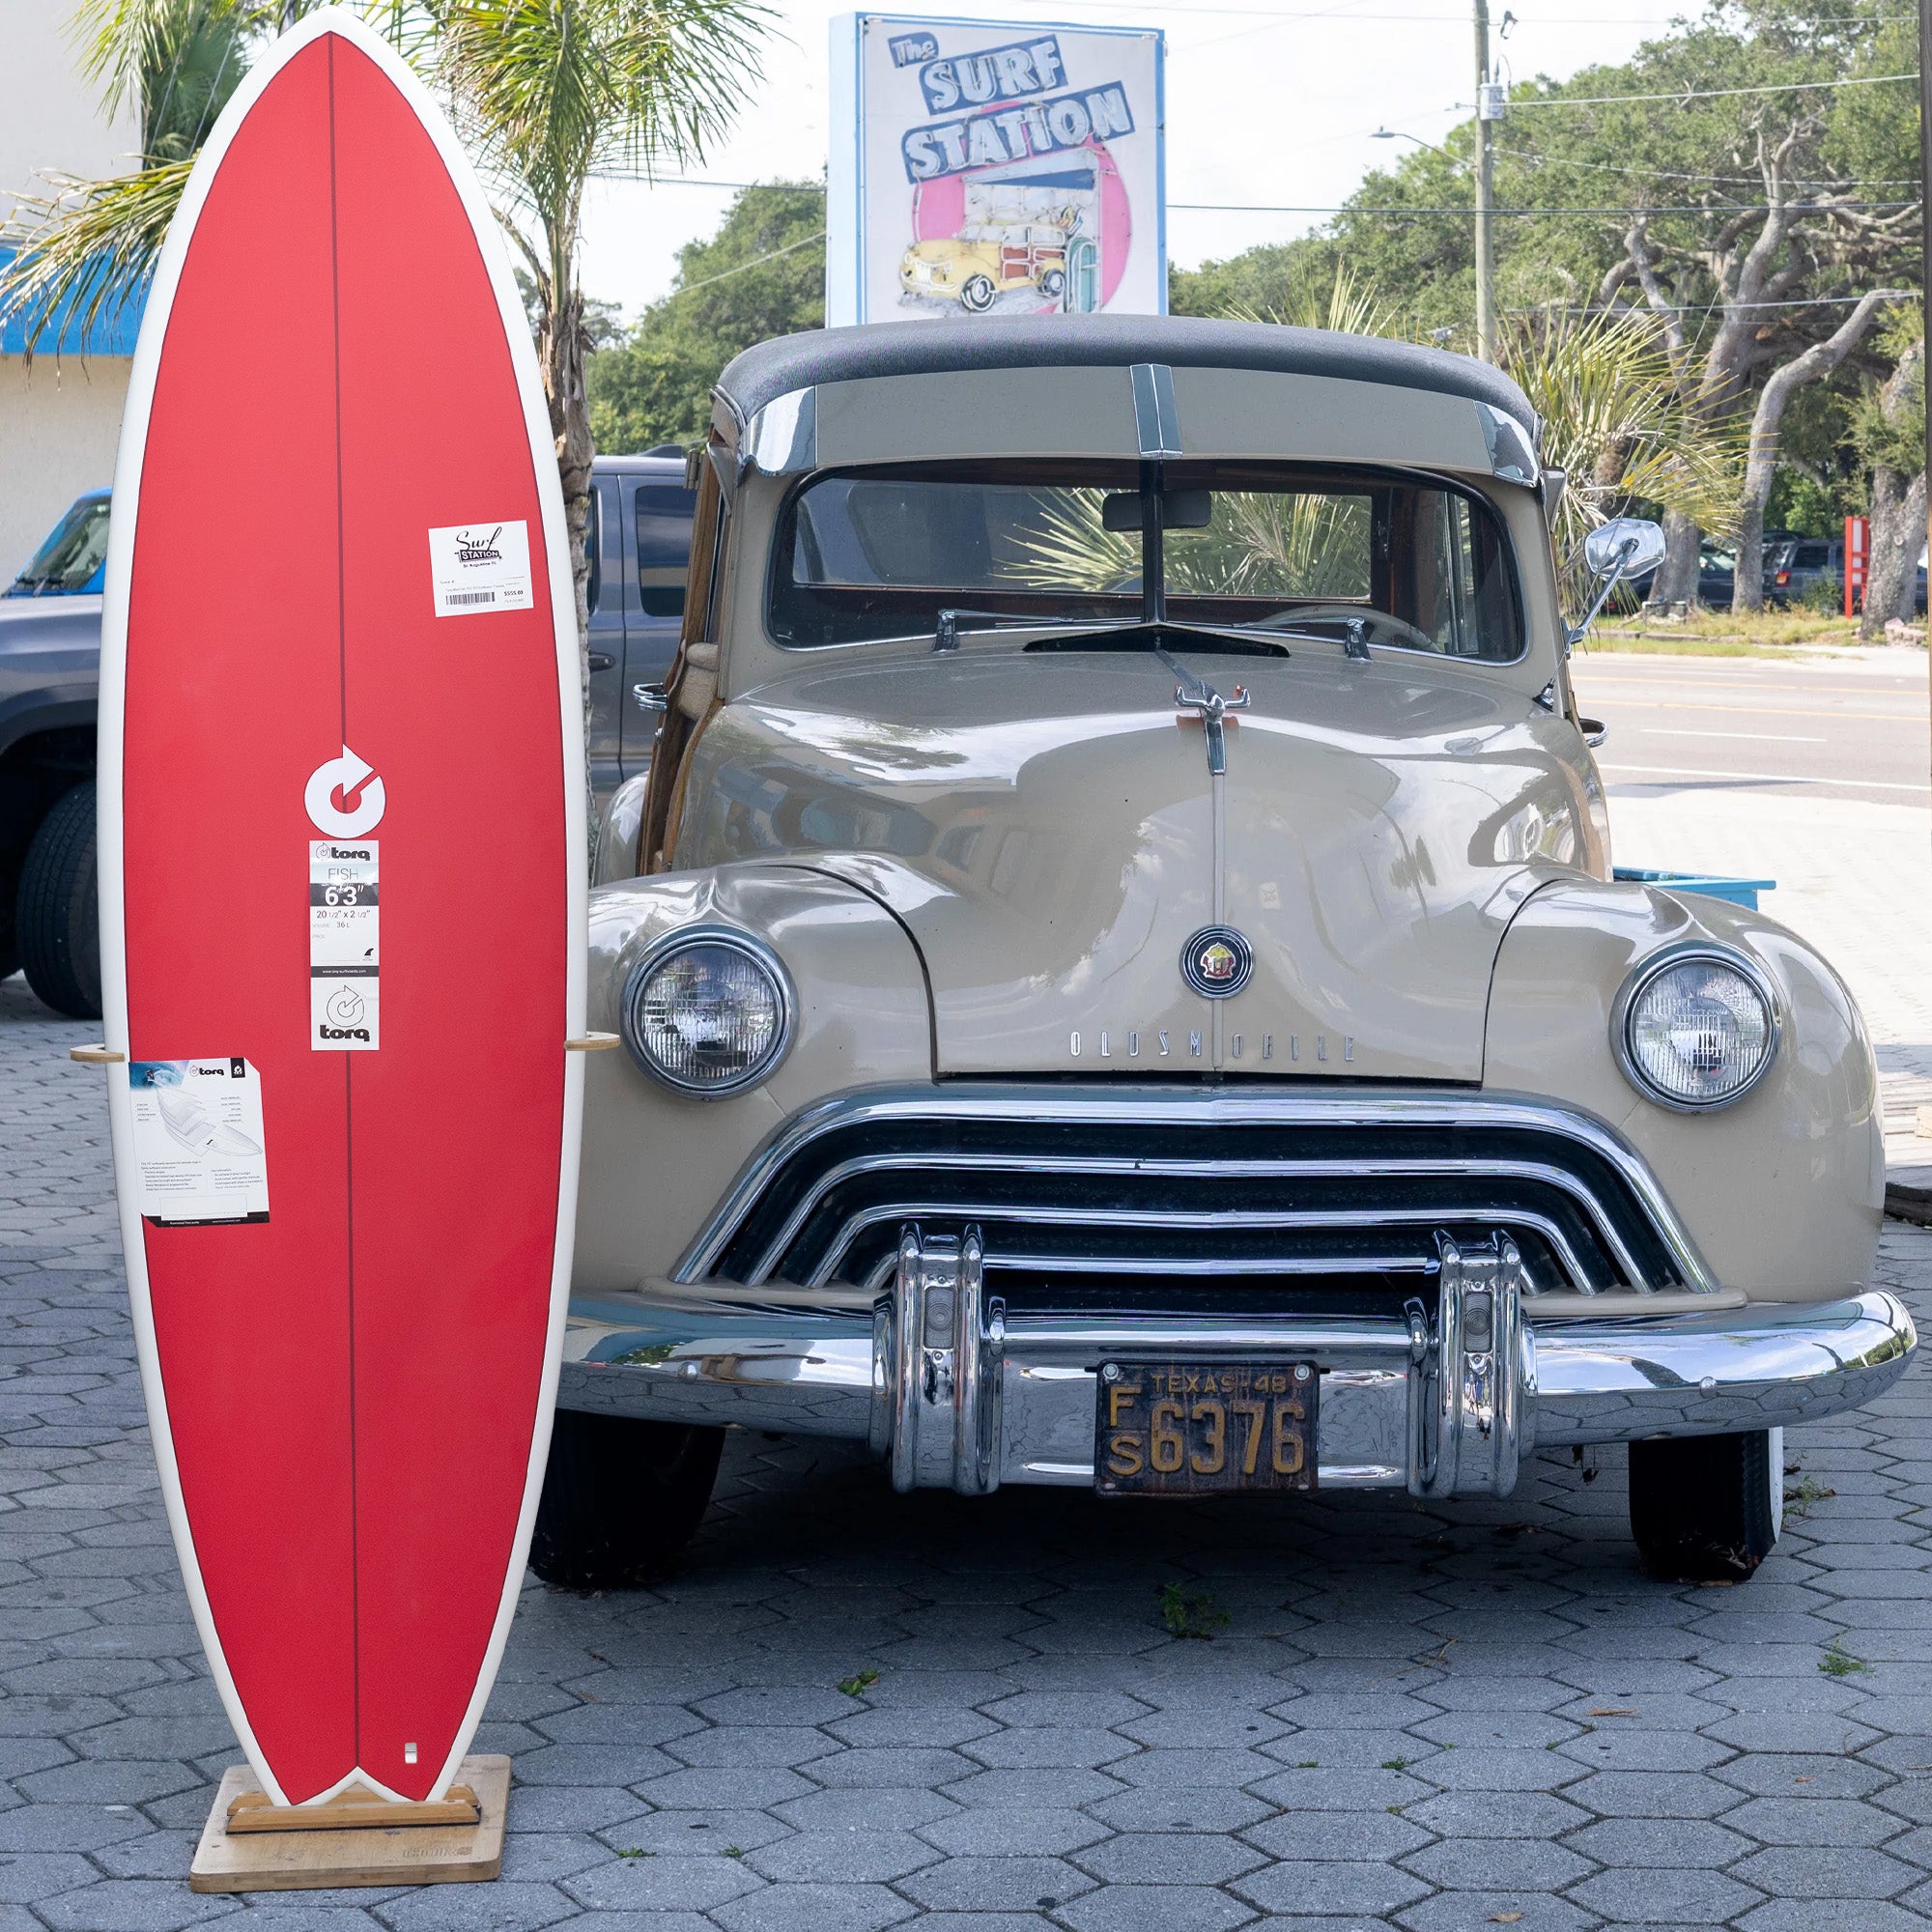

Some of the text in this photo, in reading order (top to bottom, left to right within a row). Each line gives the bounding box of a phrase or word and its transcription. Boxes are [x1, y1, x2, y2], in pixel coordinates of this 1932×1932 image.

[893, 39, 937, 62] The
[923, 42, 1061, 110] SURF
[905, 88, 1130, 178] STATION
[456, 526, 502, 551] Surf
[460, 551, 499, 560] STATION
[331, 847, 370, 861] torq
[328, 868, 358, 880] FISH
[317, 910, 327, 919] 20
[350, 910, 355, 919] 2
[320, 1024, 370, 1042] torq
[1070, 1030, 1354, 1062] OLDSMOBILE
[199, 1067, 224, 1076] torq
[1110, 1385, 1142, 1427] F
[1151, 1402, 1305, 1474] 6376
[1108, 1435, 1143, 1475] S
